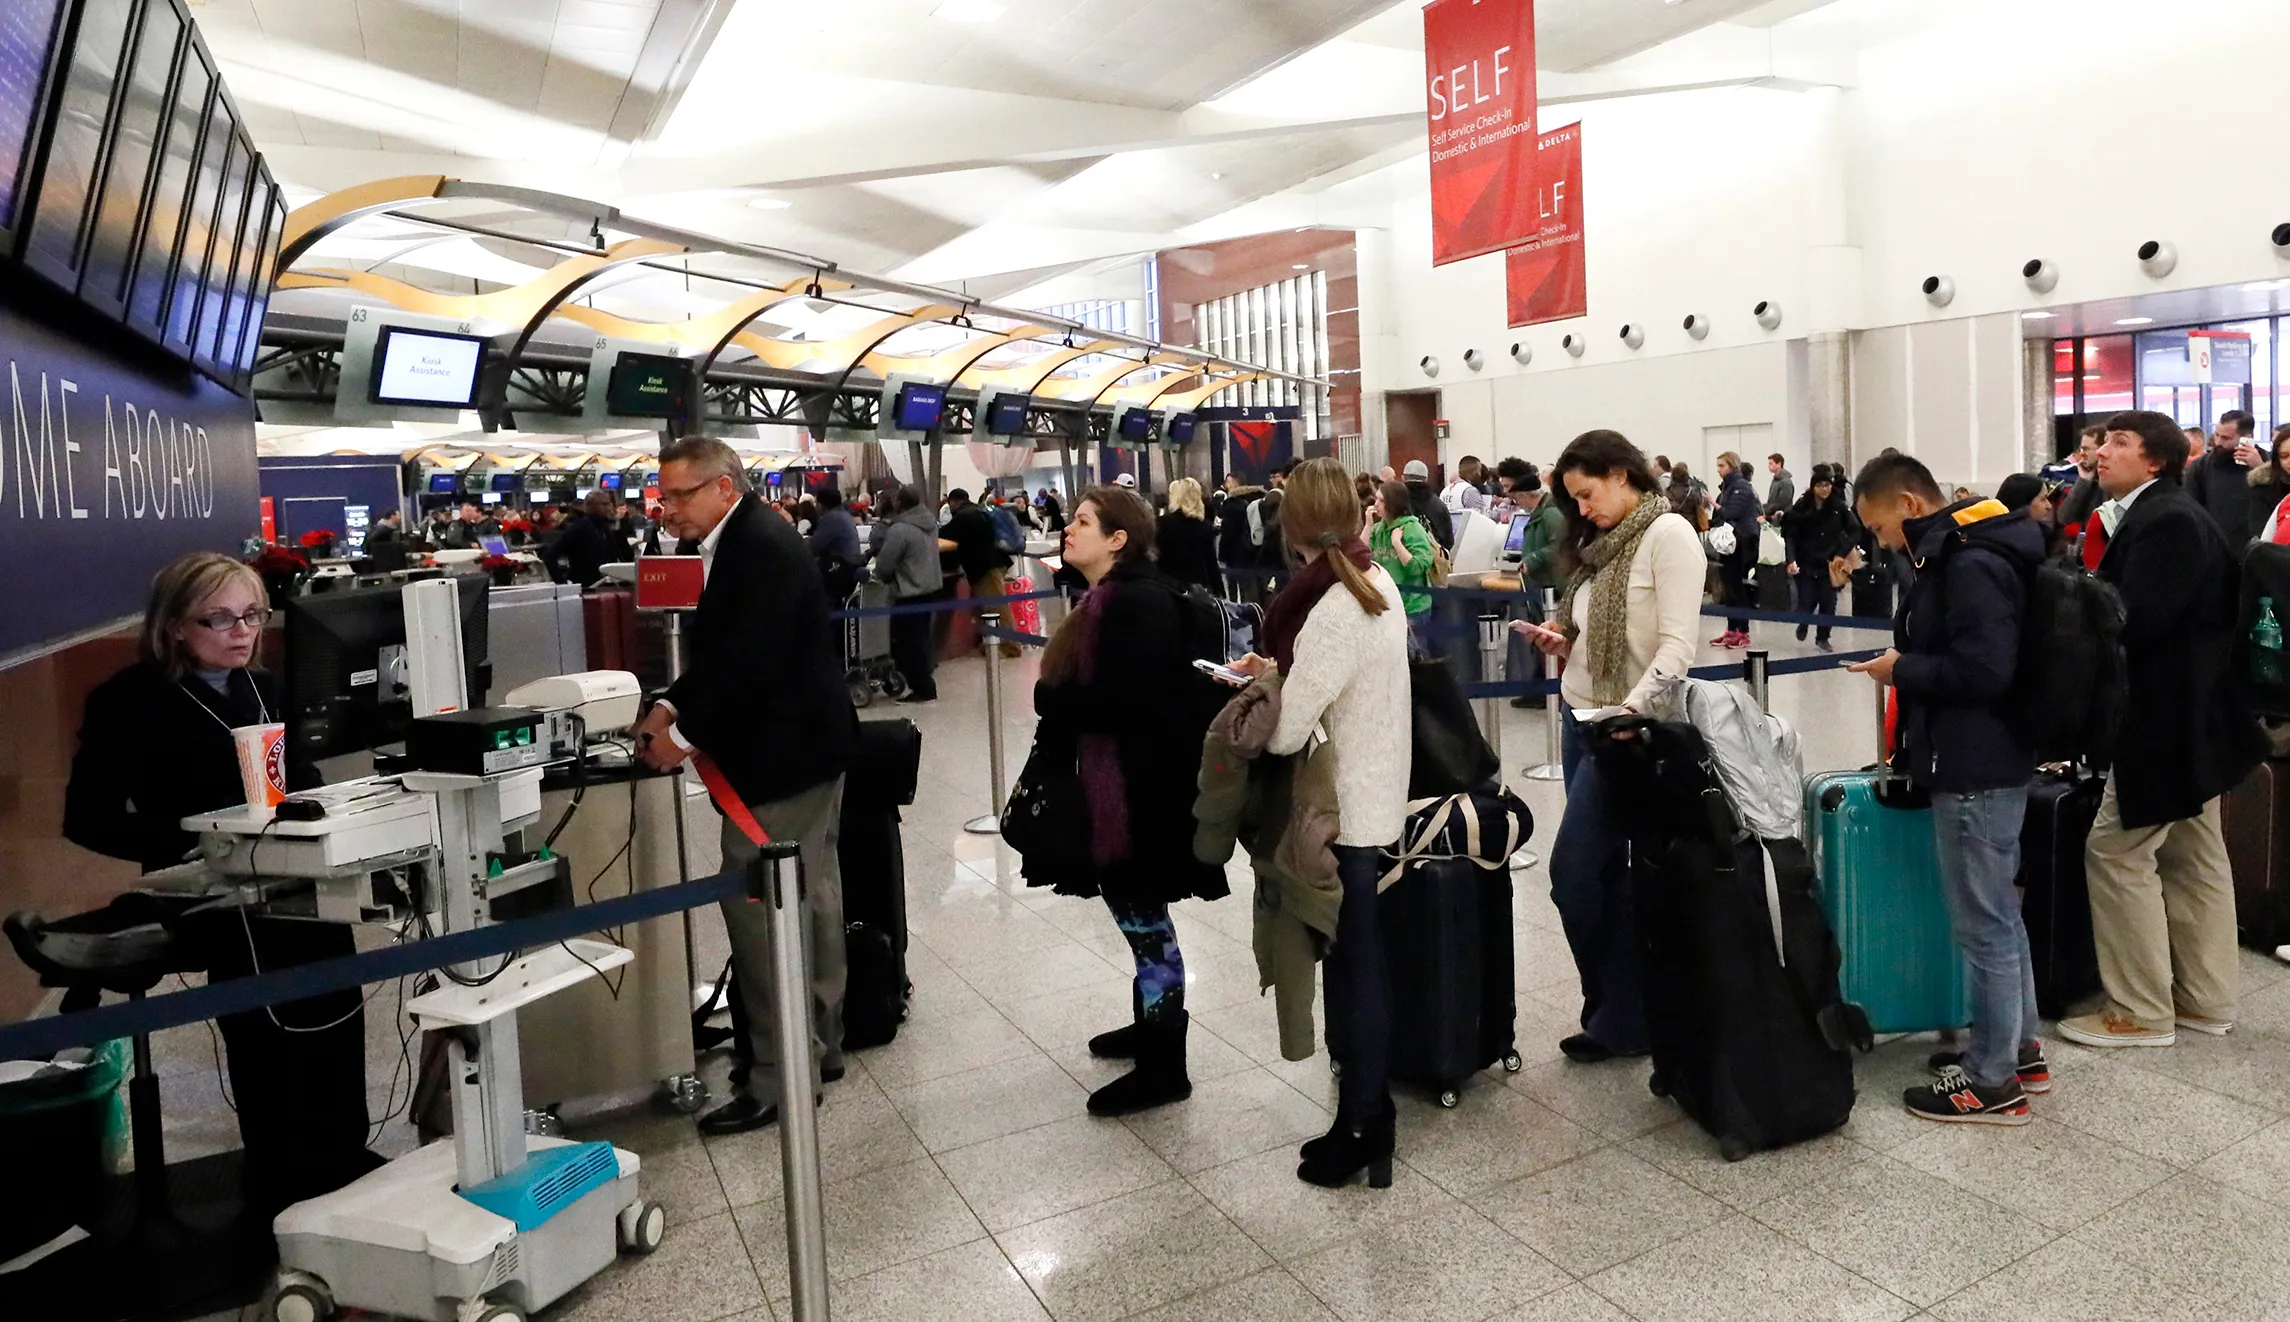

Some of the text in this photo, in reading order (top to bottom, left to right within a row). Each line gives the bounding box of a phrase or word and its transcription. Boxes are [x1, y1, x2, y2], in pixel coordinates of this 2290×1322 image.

[1430, 45, 1511, 121] SELF
[1431, 107, 1512, 147] Self Service Check-In
[1432, 116, 1531, 163] Domestic & International
[1545, 132, 1571, 148] DELTA
[1539, 180, 1566, 218] LF
[1507, 243, 1535, 257] Domestic
[1541, 230, 1580, 248] International
[352, 309, 368, 323] 63
[457, 322, 471, 334] 64
[595, 338, 607, 350] 65
[421, 356, 442, 365] Kiosk
[409, 365, 451, 377] Assistance
[647, 376, 664, 385] Kiosk
[638, 384, 668, 394] Assistance
[1242, 407, 1249, 416] 3
[0, 360, 213, 520] ME ABOARD
[643, 572, 667, 582] EXIT
[1949, 1088, 1984, 1114] N
